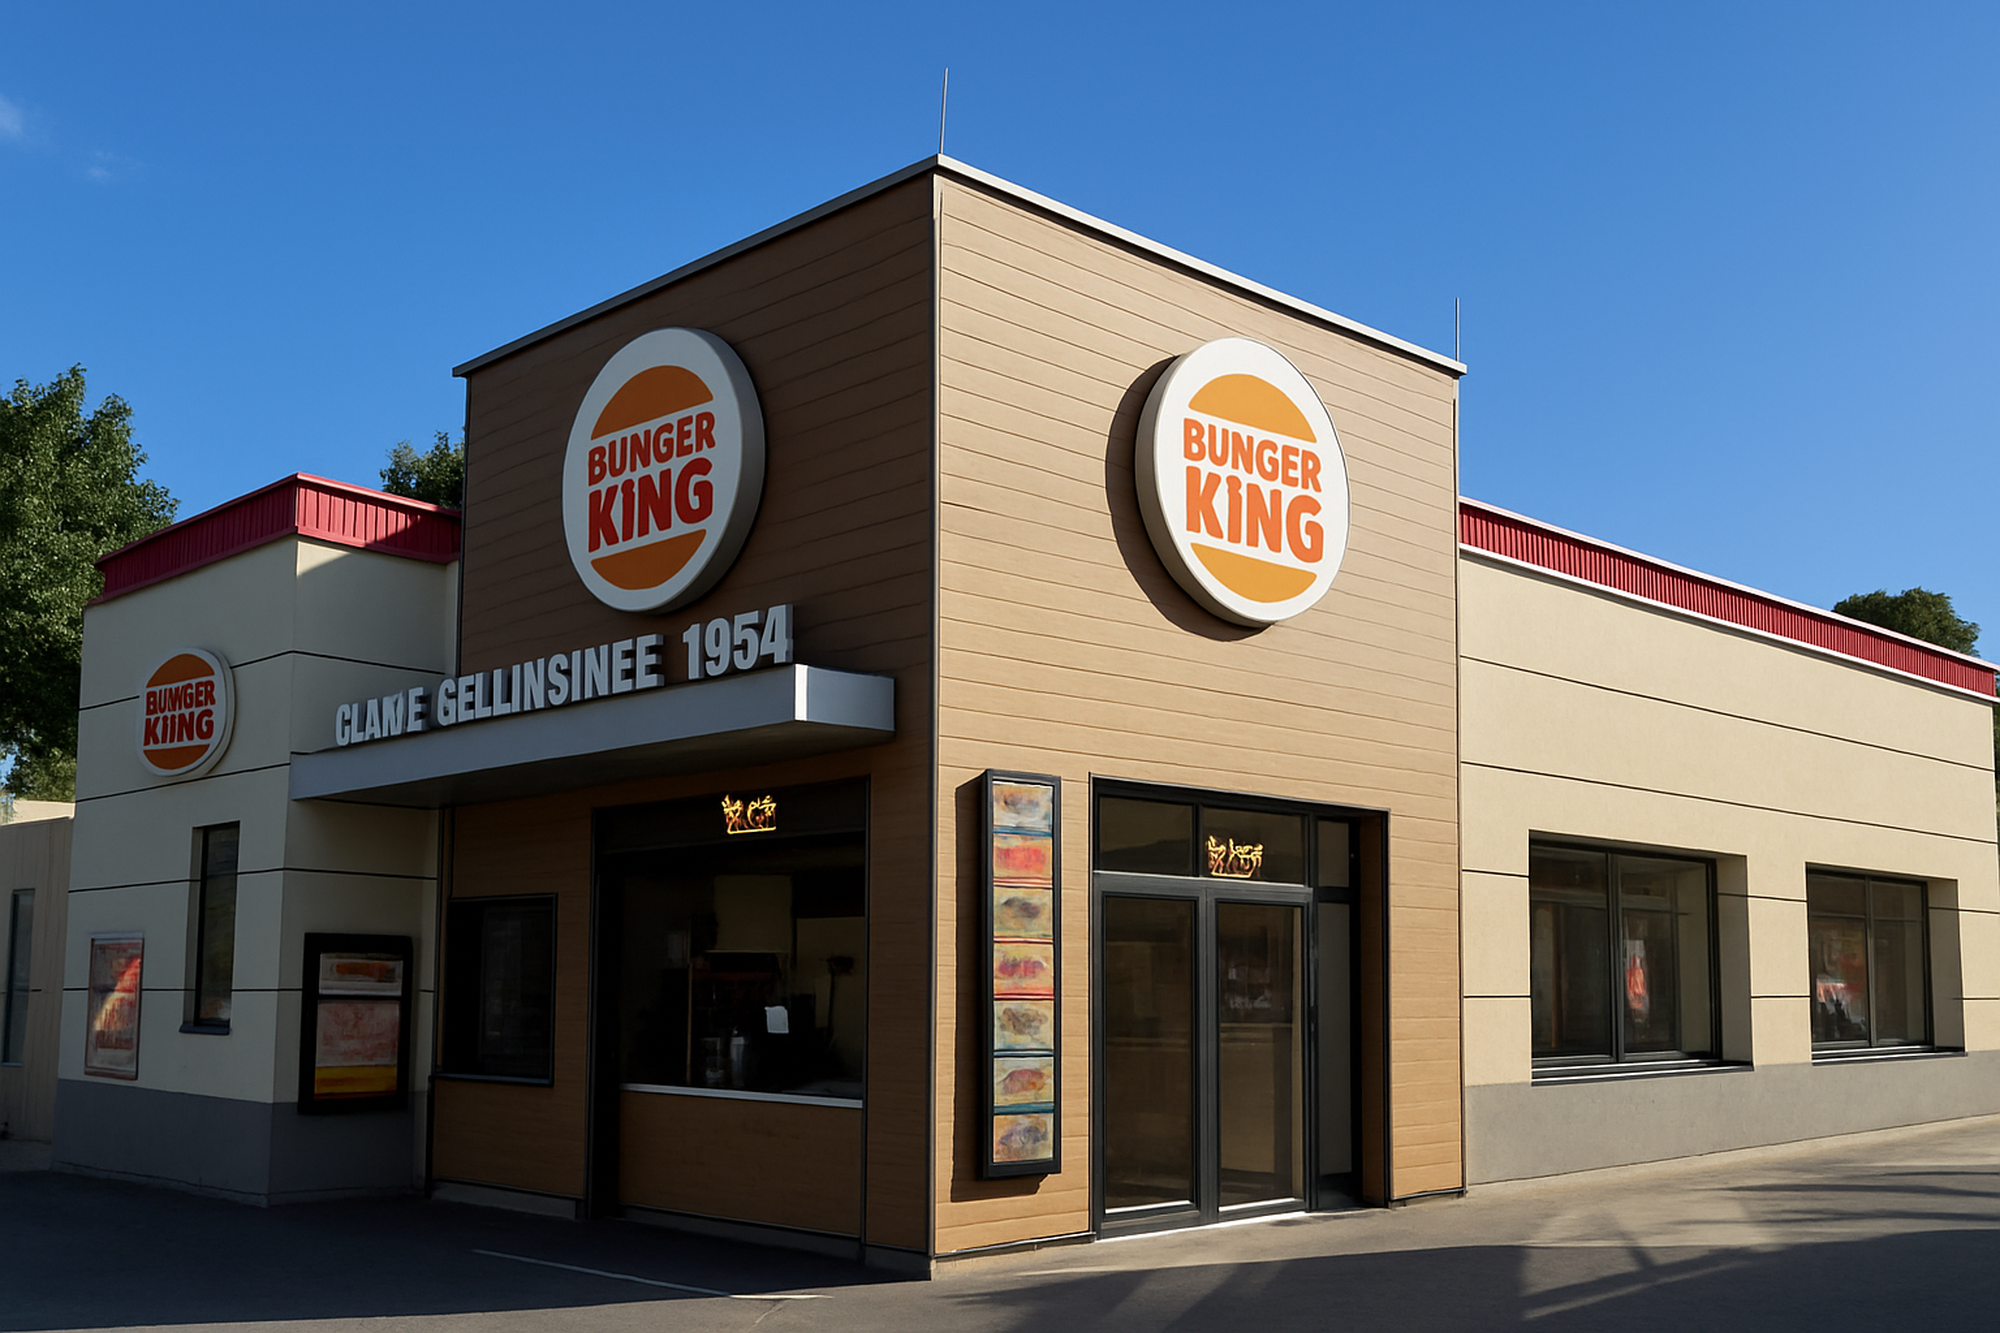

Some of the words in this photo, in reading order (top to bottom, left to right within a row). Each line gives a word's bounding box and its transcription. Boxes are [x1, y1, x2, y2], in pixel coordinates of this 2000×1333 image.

[588, 411, 716, 486] BUNGER
[1183, 418, 1322, 493] BUNGER
[588, 457, 714, 553] KING
[1186, 465, 1324, 563] KING
[437, 634, 665, 726] GELLINSINEE
[682, 604, 793, 680] 1954
